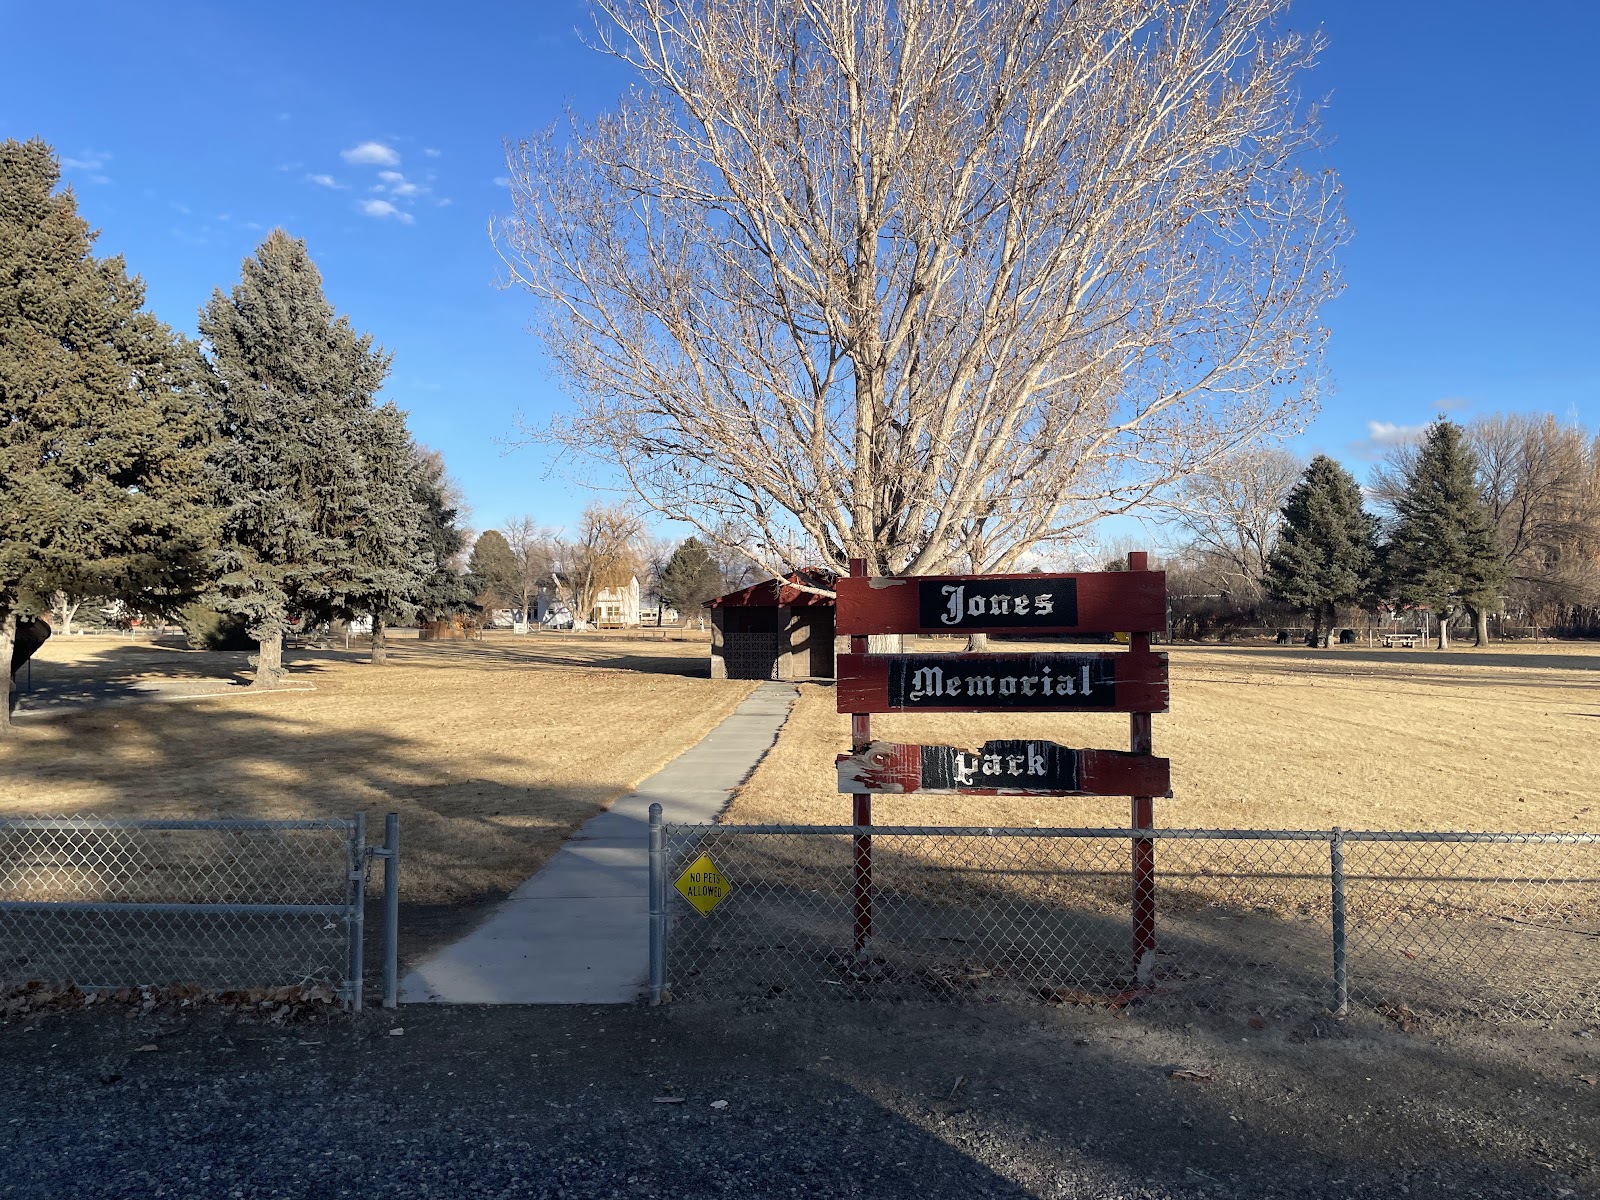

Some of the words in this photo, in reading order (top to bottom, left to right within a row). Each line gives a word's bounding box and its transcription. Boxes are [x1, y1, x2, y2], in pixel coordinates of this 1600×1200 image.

[941, 585, 1054, 625] Jones
[910, 665, 1093, 701] Memorial
[690, 872, 700, 882] NO
[704, 872, 720, 884] PETS
[688, 886, 722, 898] ALLOWED
